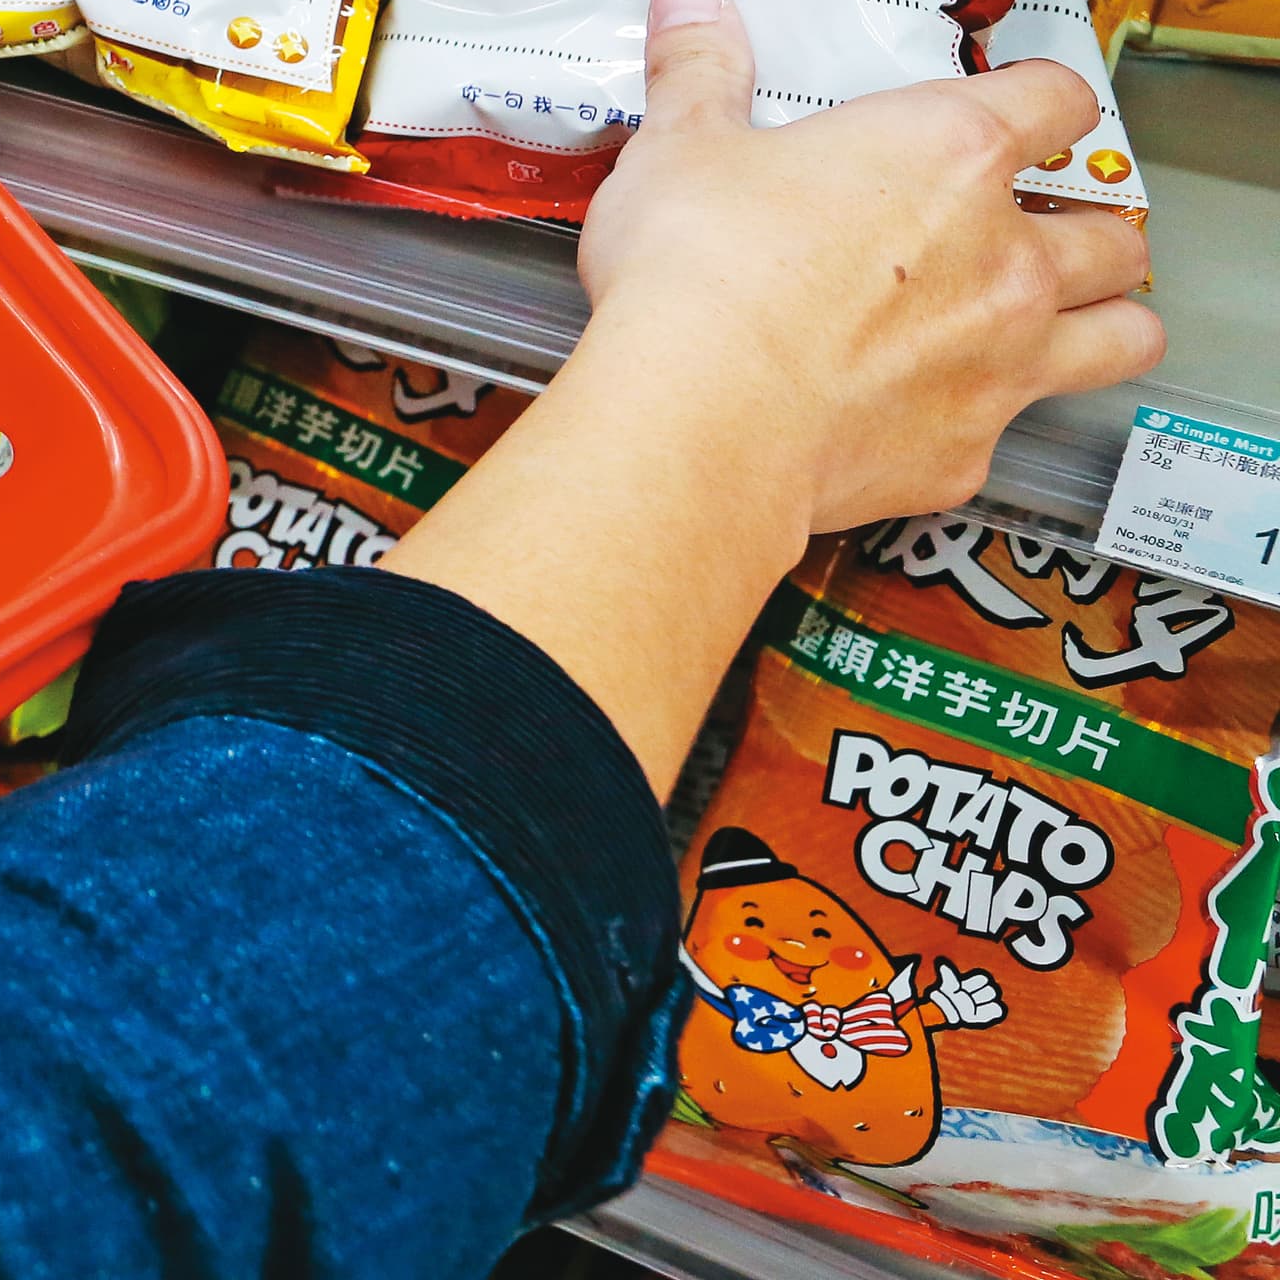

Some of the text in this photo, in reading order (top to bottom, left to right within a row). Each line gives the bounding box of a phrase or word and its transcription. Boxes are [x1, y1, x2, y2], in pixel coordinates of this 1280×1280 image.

[462, 85, 523, 110] 你一句
[534, 95, 598, 122] 我一句
[1172, 422, 1274, 458] Simple Mart
[1140, 449, 1173, 471] 52g
[1131, 506, 1194, 530] 2018/03/31
[1157, 496, 1213, 521] 美廉價
[1116, 526, 1183, 553] No.40828
[1173, 529, 1190, 540] NR
[790, 606, 1121, 772] 整顆洋芋切片
[829, 732, 1107, 886] POTATO
[860, 820, 1087, 967] CHIPS
